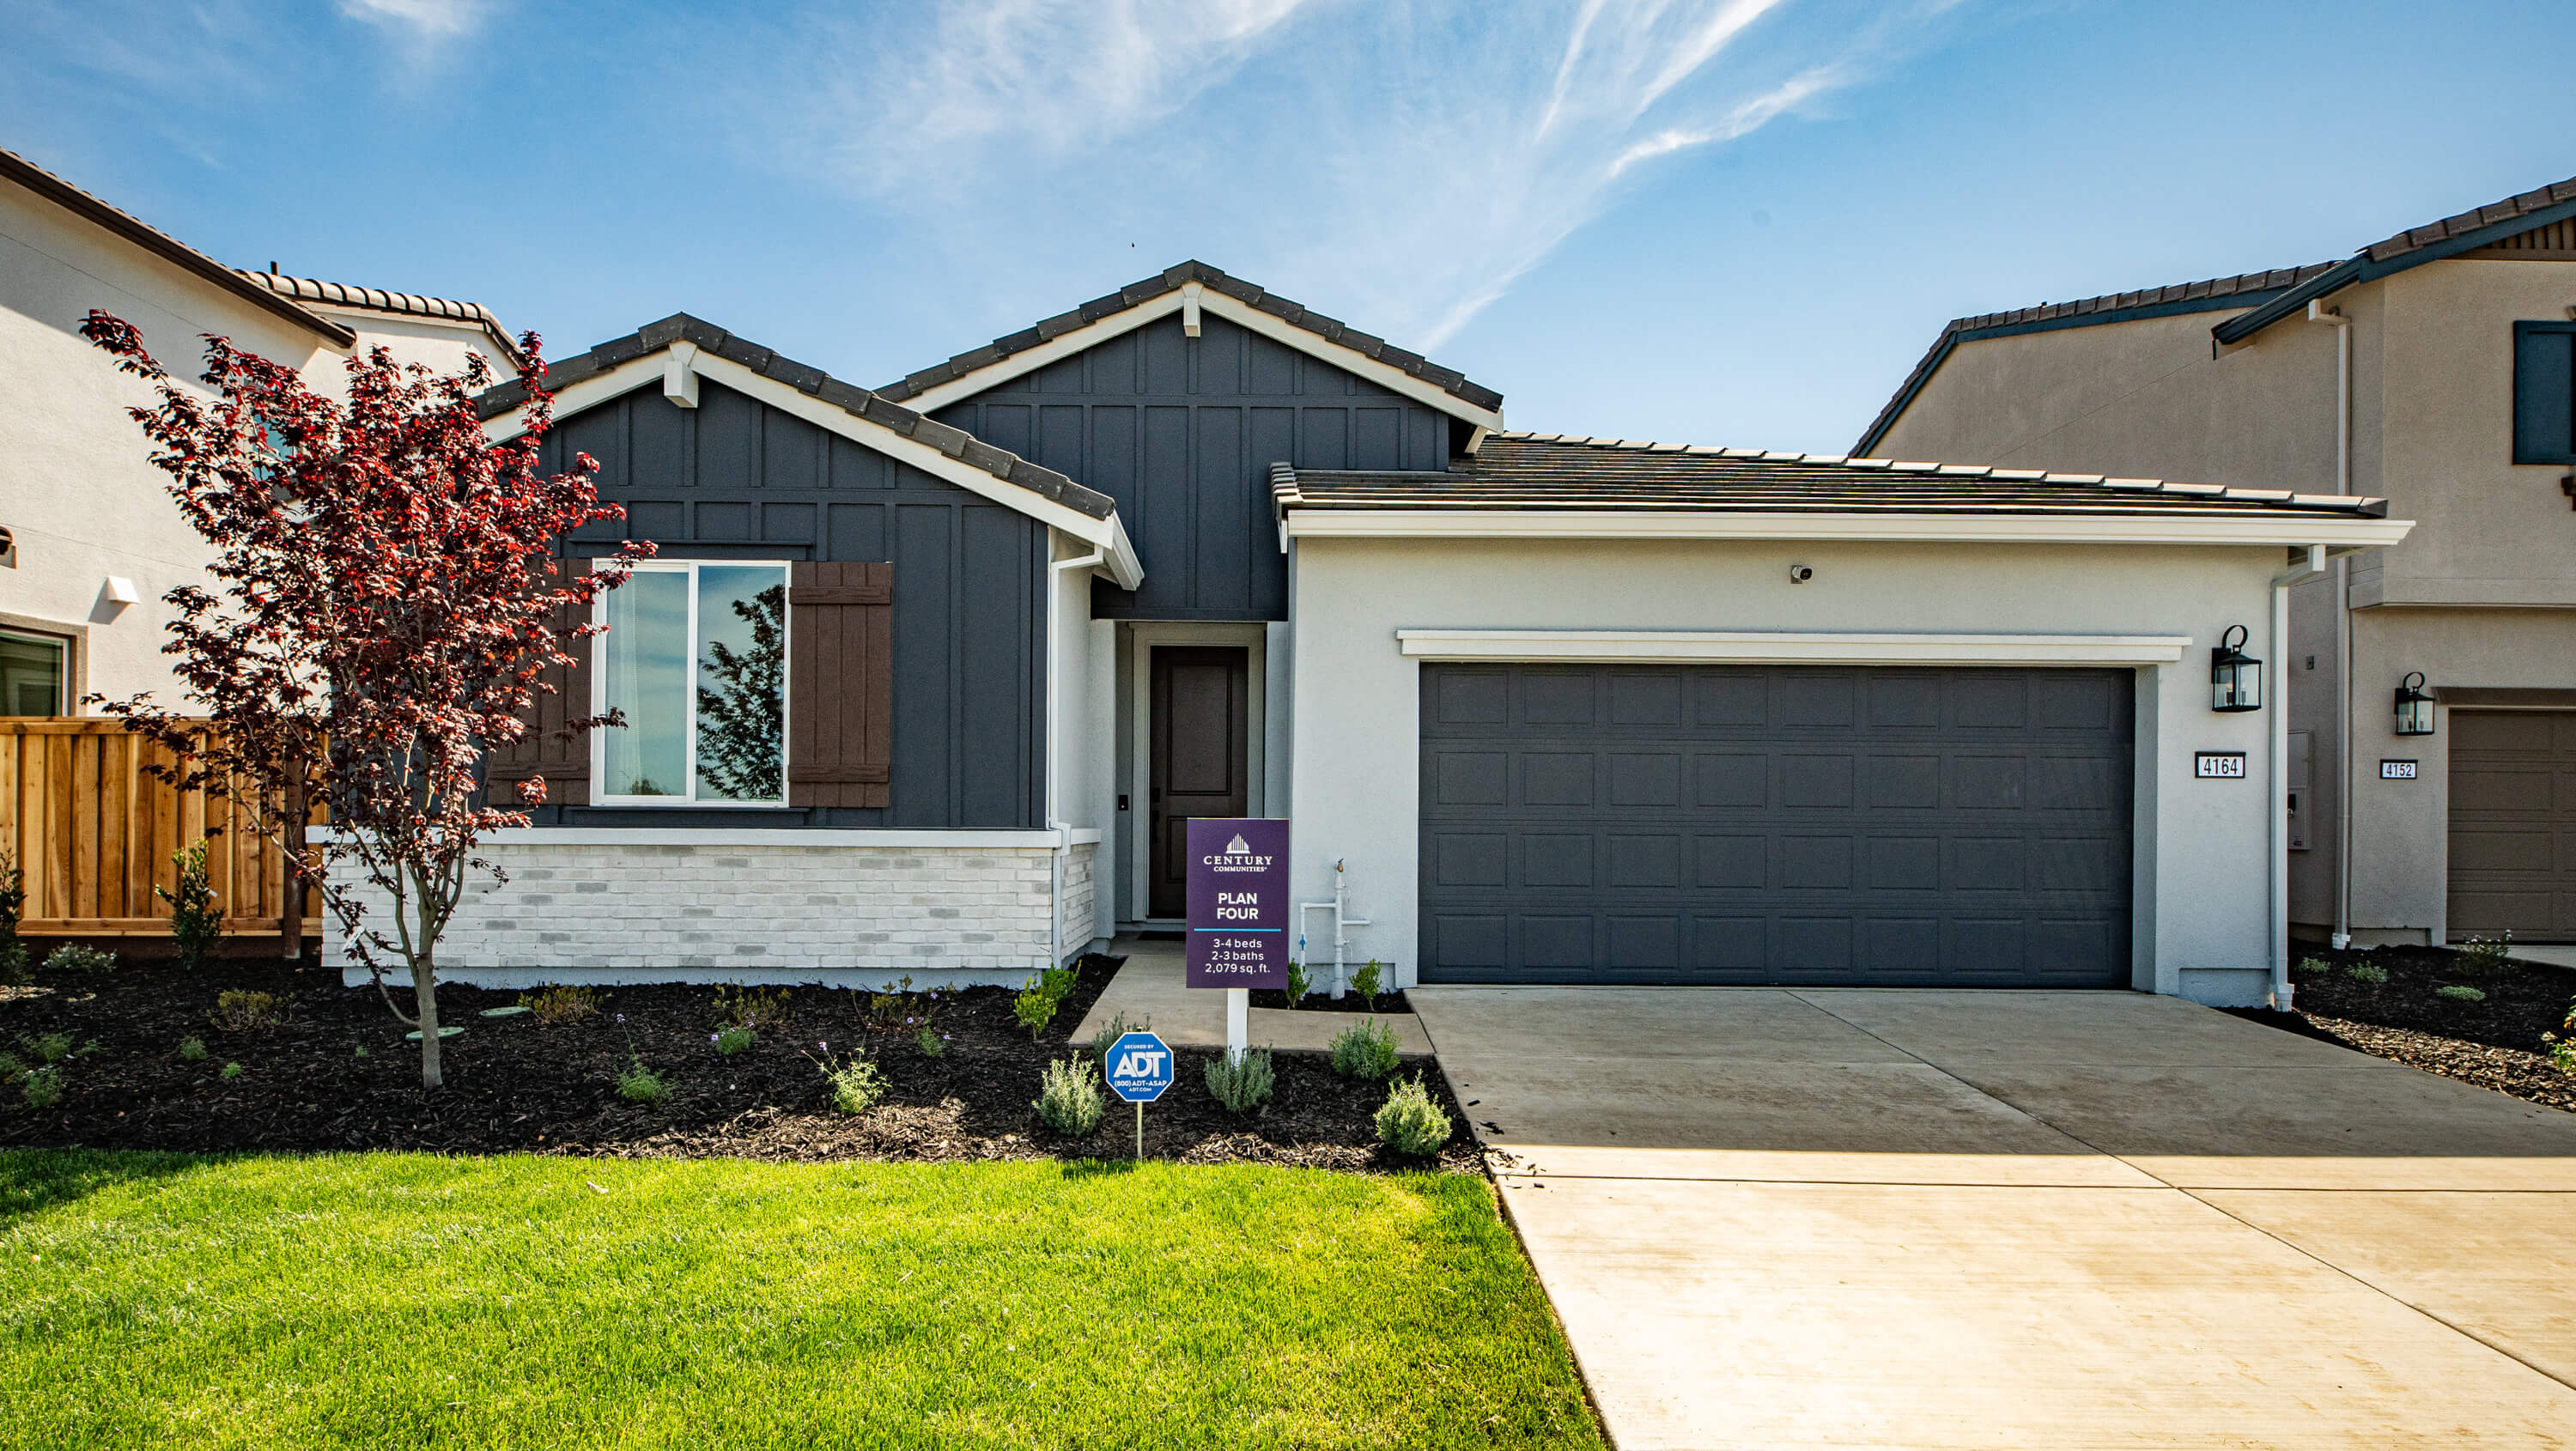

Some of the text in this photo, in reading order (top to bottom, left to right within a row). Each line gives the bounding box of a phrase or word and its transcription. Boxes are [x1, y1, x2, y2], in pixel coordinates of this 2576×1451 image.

[2204, 758, 2237, 774] 4164
[2386, 764, 2412, 776] 4152
[1203, 856, 1273, 865] CENTURY
[1218, 892, 1258, 904] PLAN
[1217, 908, 1259, 920] FOUR
[1213, 938, 1262, 948] 3-4 beds
[1212, 951, 1264, 961] 2-3 baths
[1205, 963, 1271, 975] 2,079 sq. ft.
[1113, 1052, 1166, 1078] ADT
